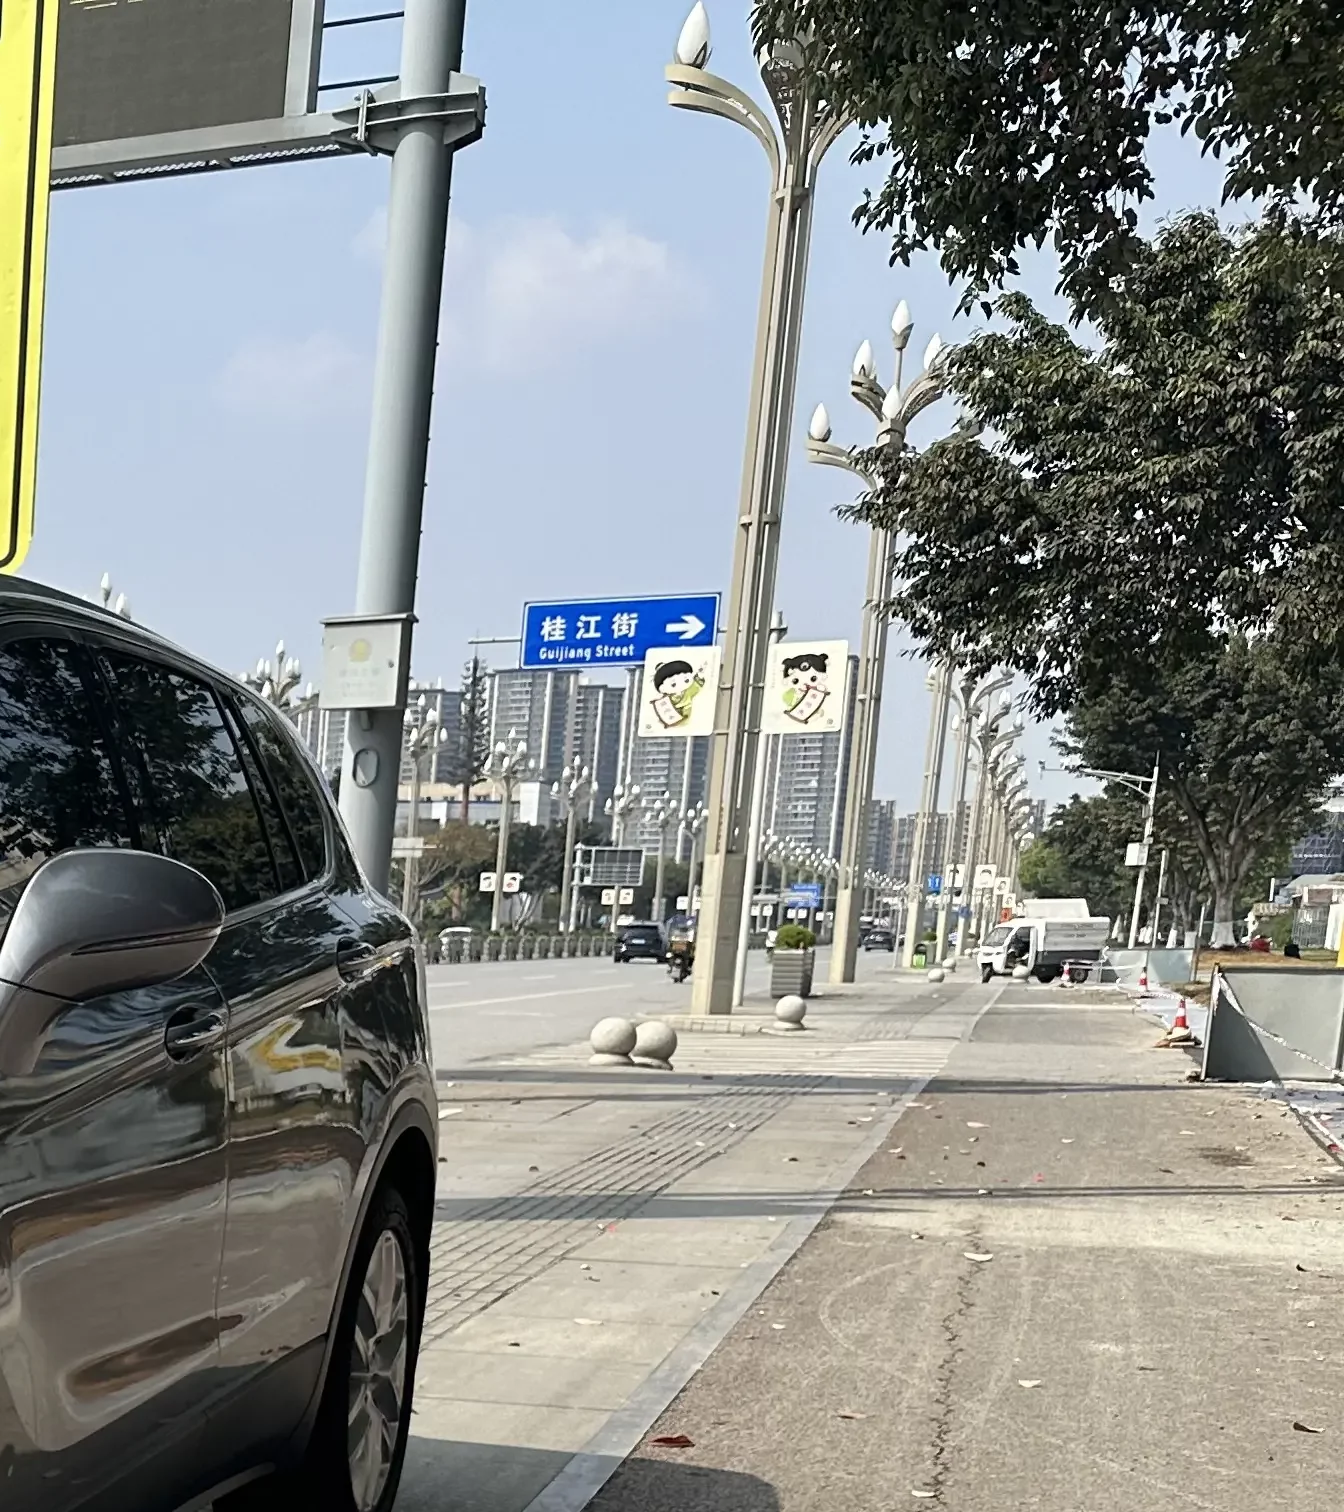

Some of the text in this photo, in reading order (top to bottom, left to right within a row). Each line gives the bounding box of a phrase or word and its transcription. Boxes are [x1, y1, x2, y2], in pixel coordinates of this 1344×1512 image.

[540, 612, 639, 642] 桂江街
[539, 644, 635, 662] Guijiang Street
